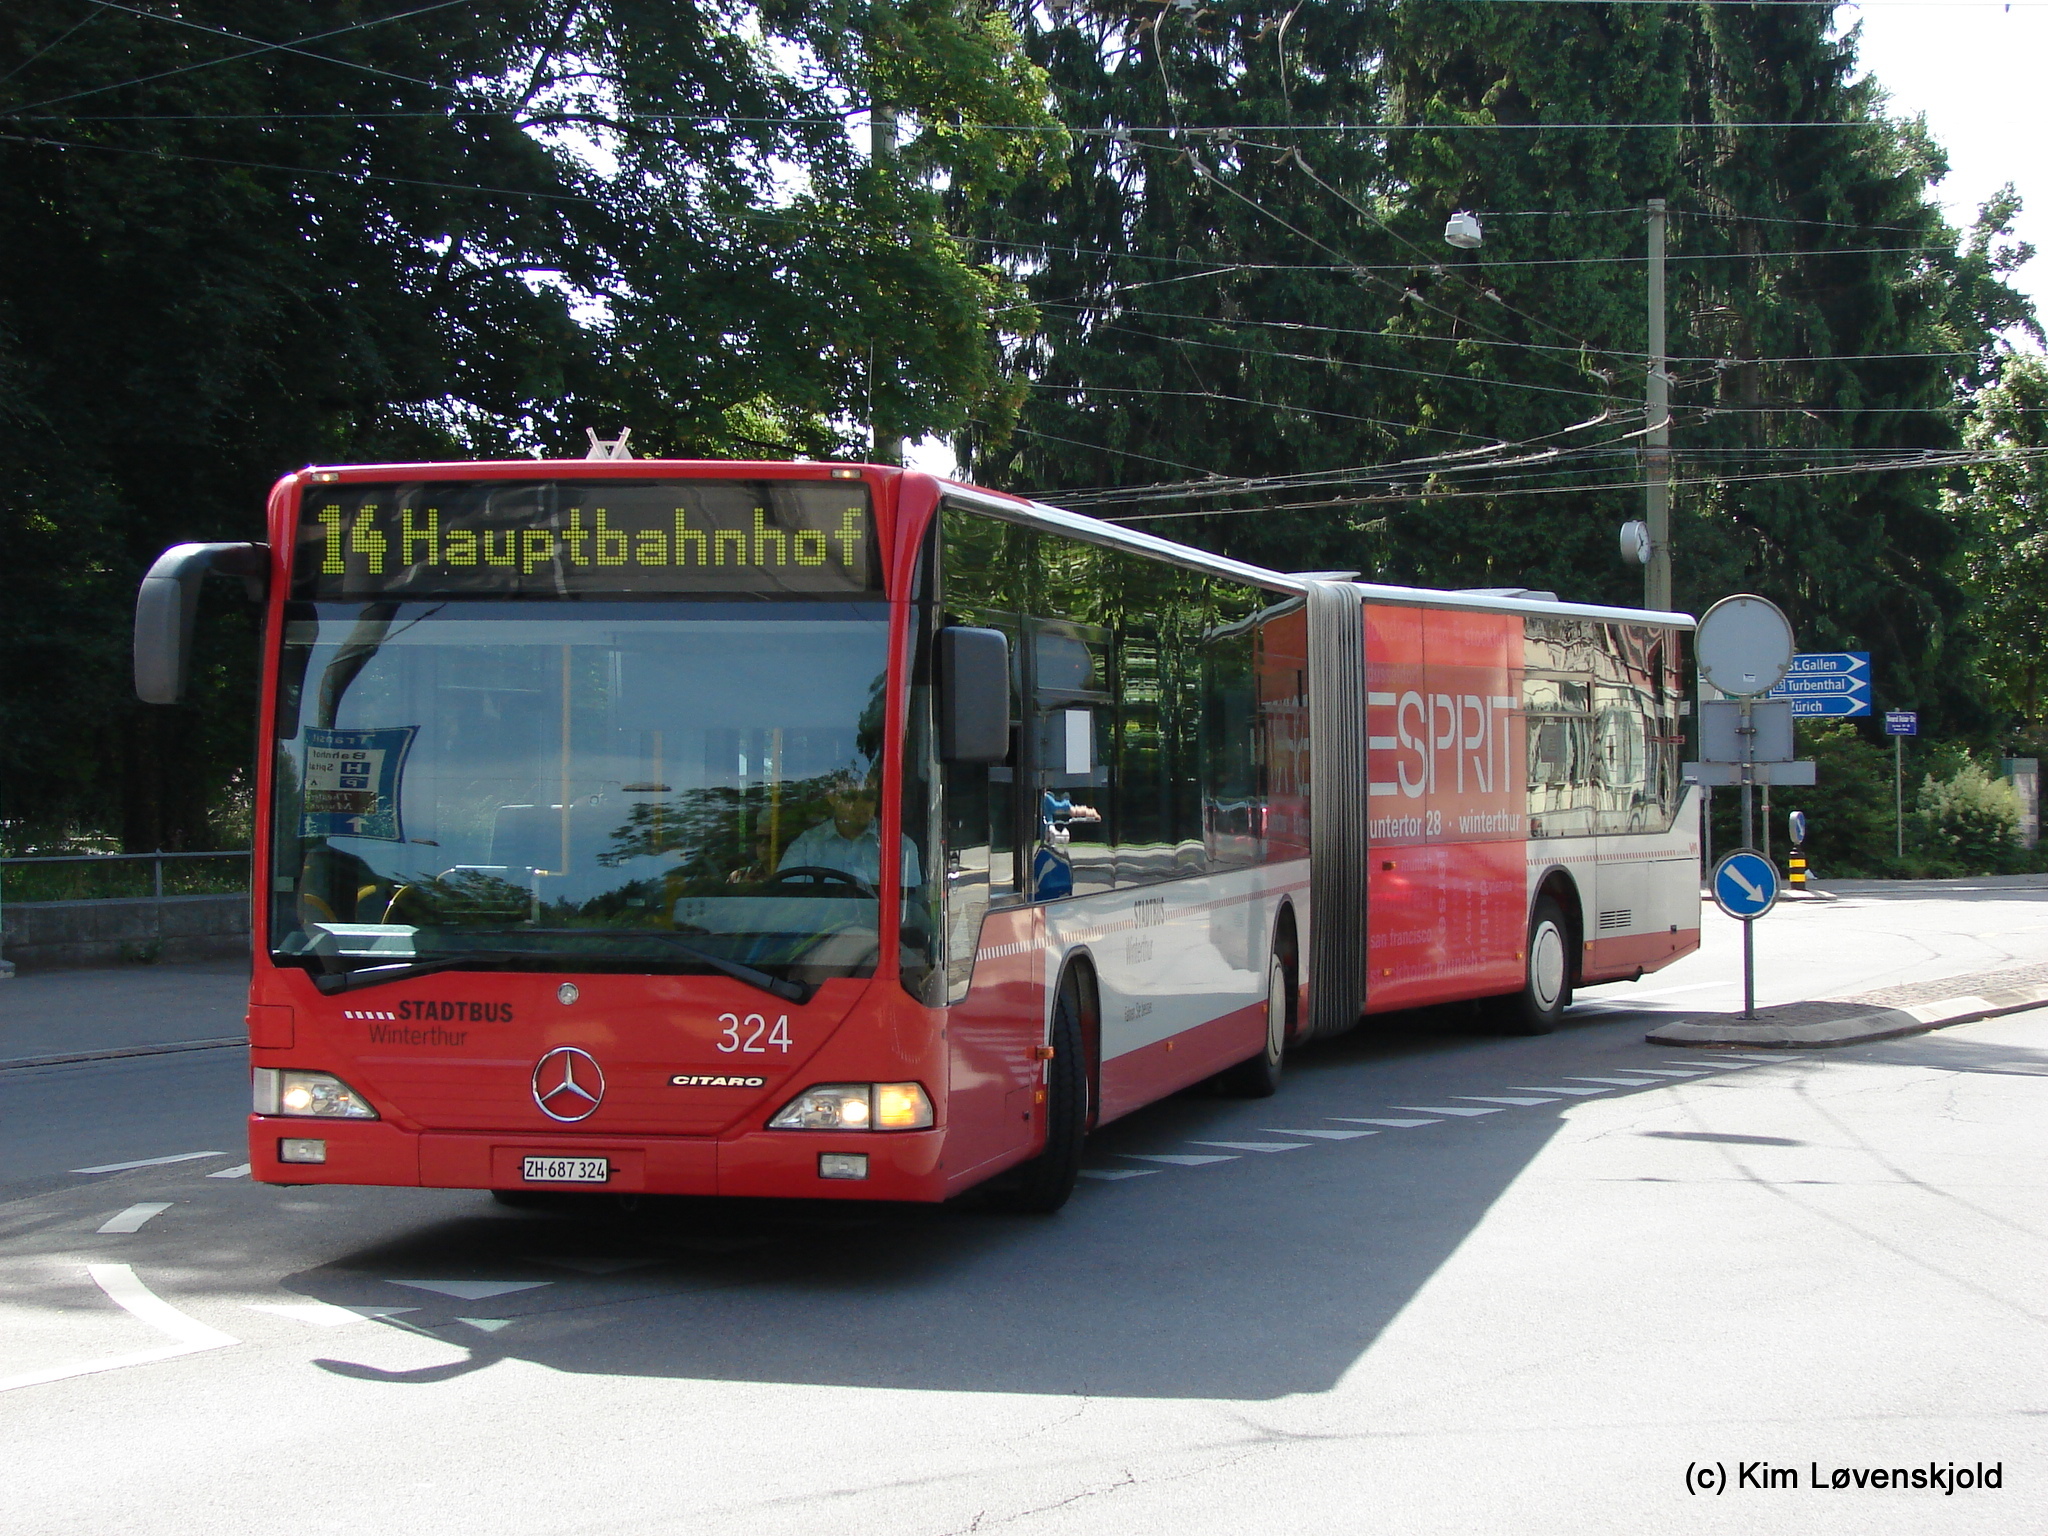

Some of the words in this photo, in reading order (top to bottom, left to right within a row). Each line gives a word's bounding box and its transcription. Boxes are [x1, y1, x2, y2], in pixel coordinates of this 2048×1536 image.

[318, 504, 387, 575] 14
[402, 507, 863, 575] Hauptbahnhof
[1787, 678, 1845, 691] Turbenthal
[1368, 690, 1518, 799] ESPRIT
[1370, 814, 1422, 839] untertor
[1426, 810, 1441, 837] 28
[1459, 809, 1521, 834] winterthur
[1370, 932, 1387, 949] san
[1390, 926, 1432, 946] francisco
[398, 1000, 513, 1023] STADTBUS
[369, 1023, 468, 1046] Winterthur
[716, 1012, 793, 1053] 324
[672, 1076, 763, 1086] CITARO
[578, 1162, 605, 1179] 324
